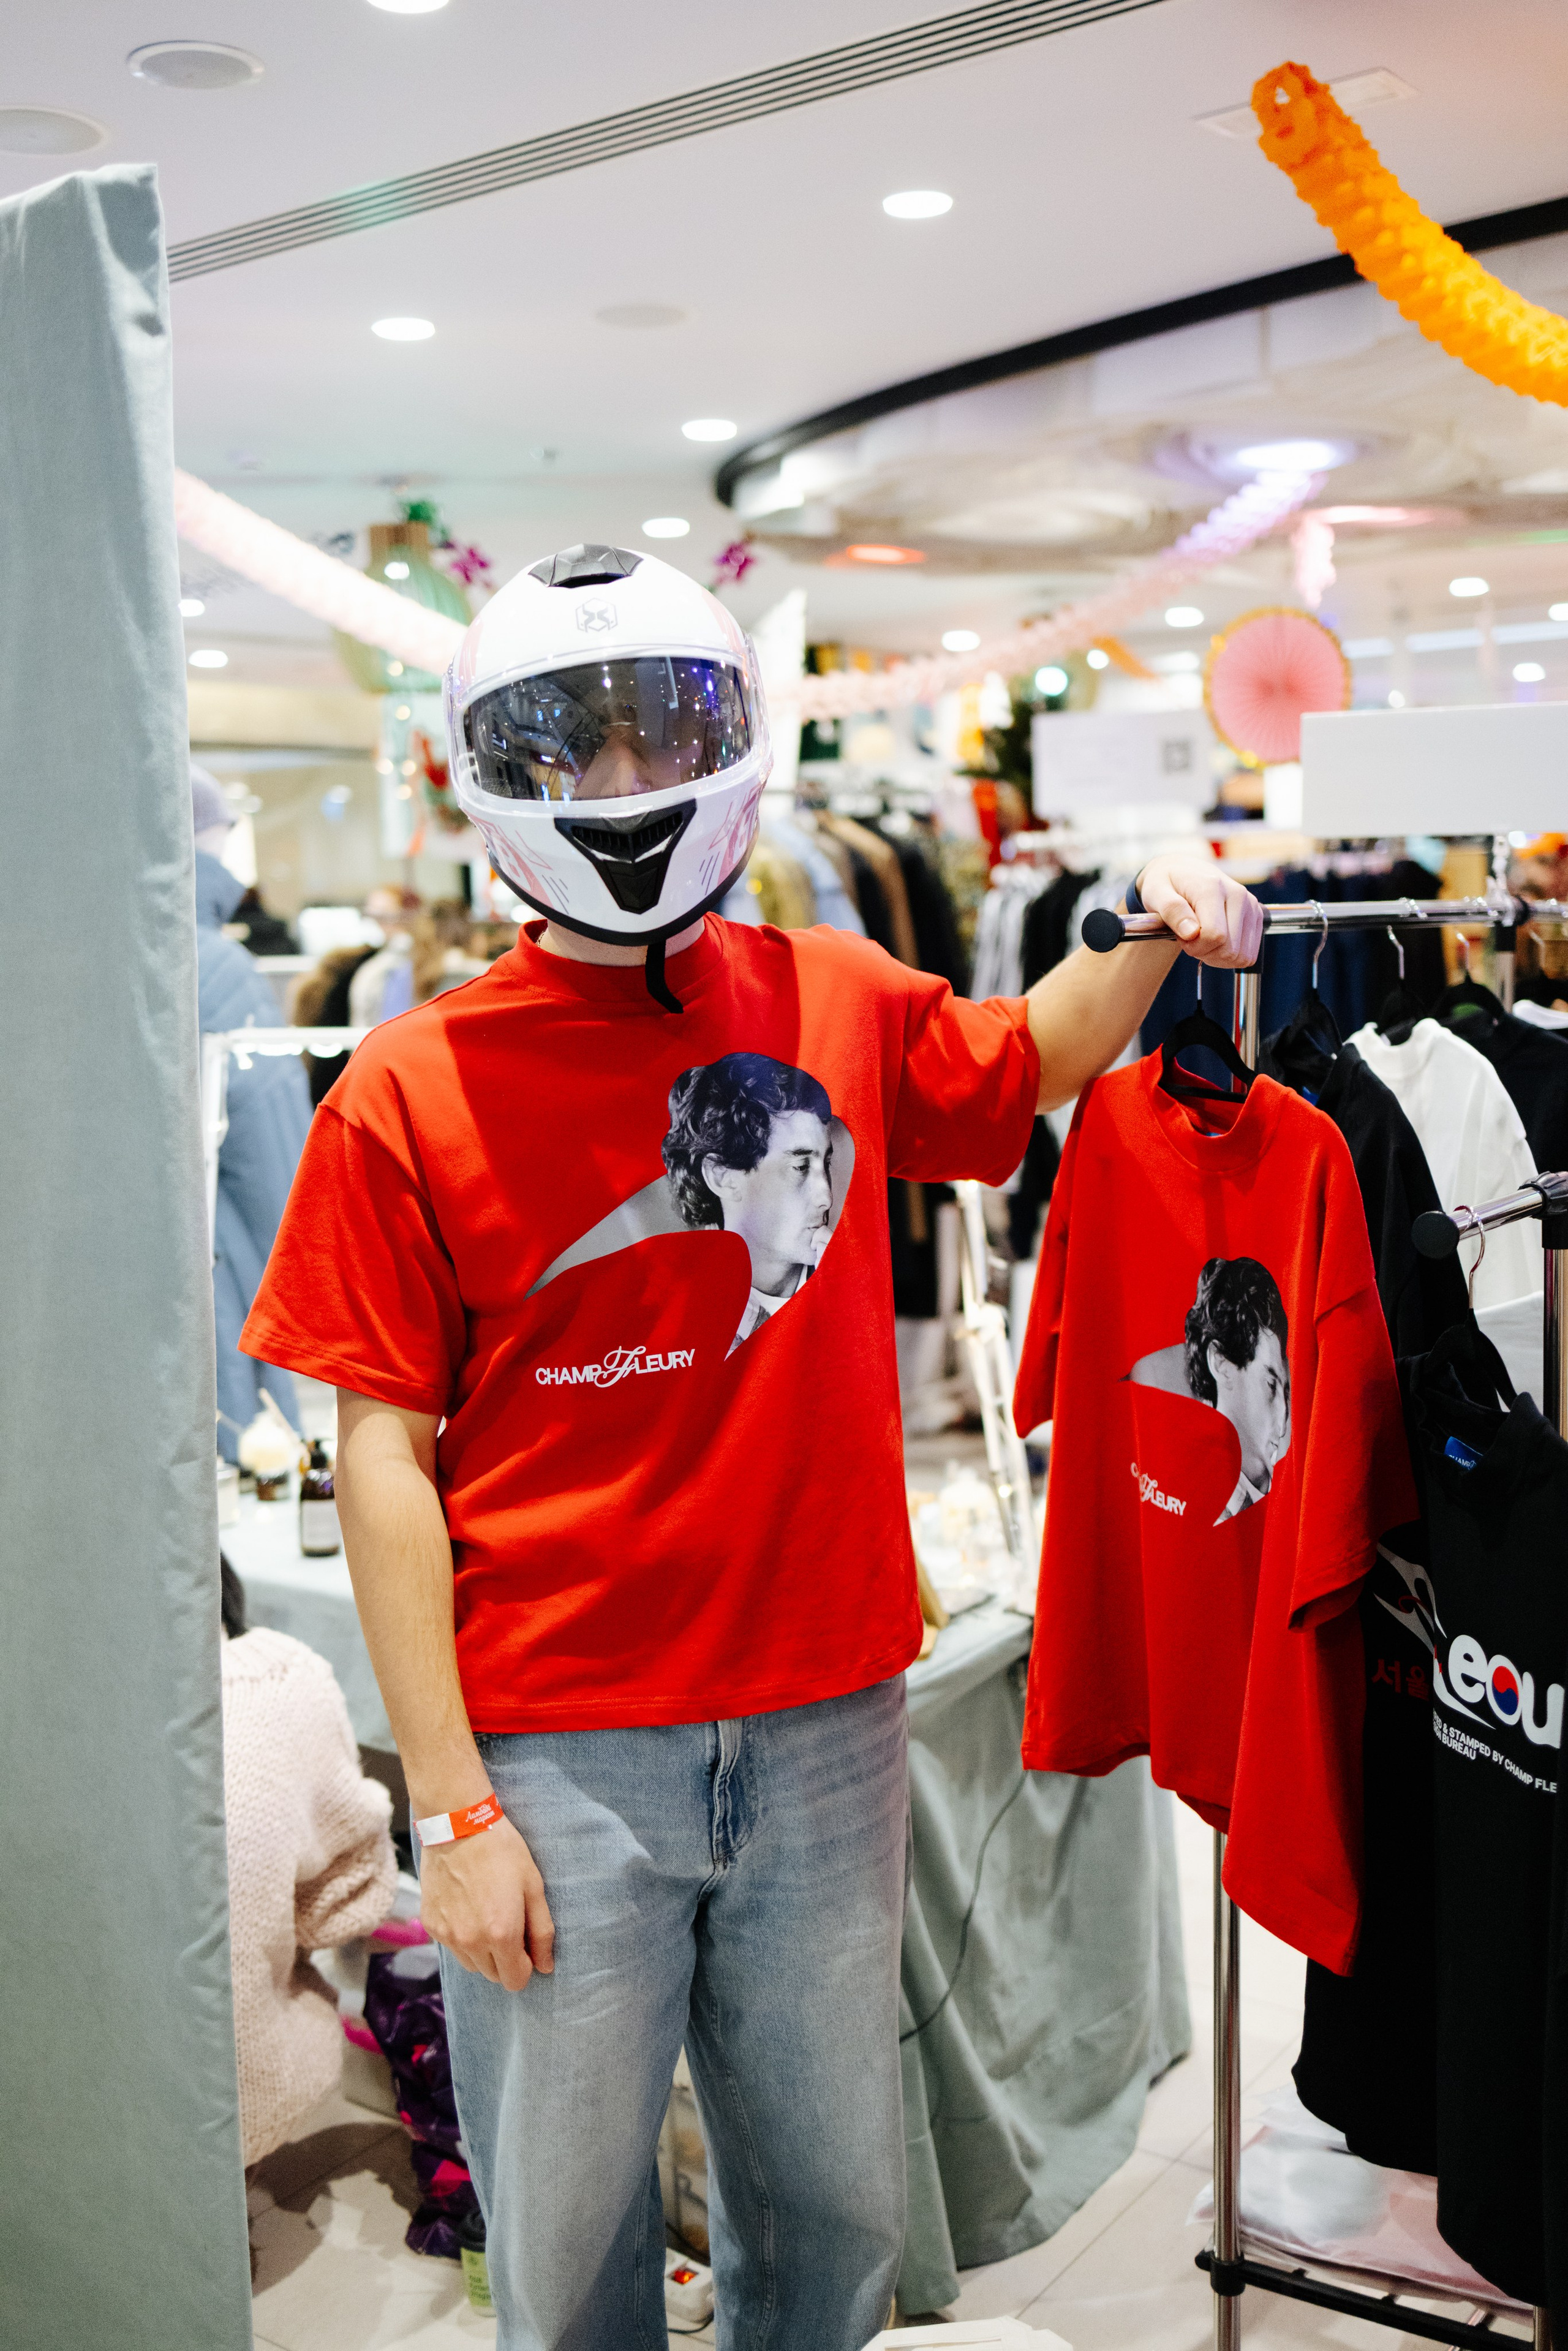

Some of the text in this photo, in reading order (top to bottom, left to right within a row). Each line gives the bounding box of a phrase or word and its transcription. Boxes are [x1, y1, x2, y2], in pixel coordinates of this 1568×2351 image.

[1371, 1658, 1430, 1702] 서울
[1442, 1732, 1476, 1760] BUREAU
[1442, 1723, 1448, 1735] &
[1449, 1727, 1491, 1757] STAMPED
[1492, 1749, 1504, 1765] BY
[1504, 1759, 1533, 1784] CHAMP
[465, 1803, 492, 1822] Ламбада
[473, 1810, 495, 1825] маркет
